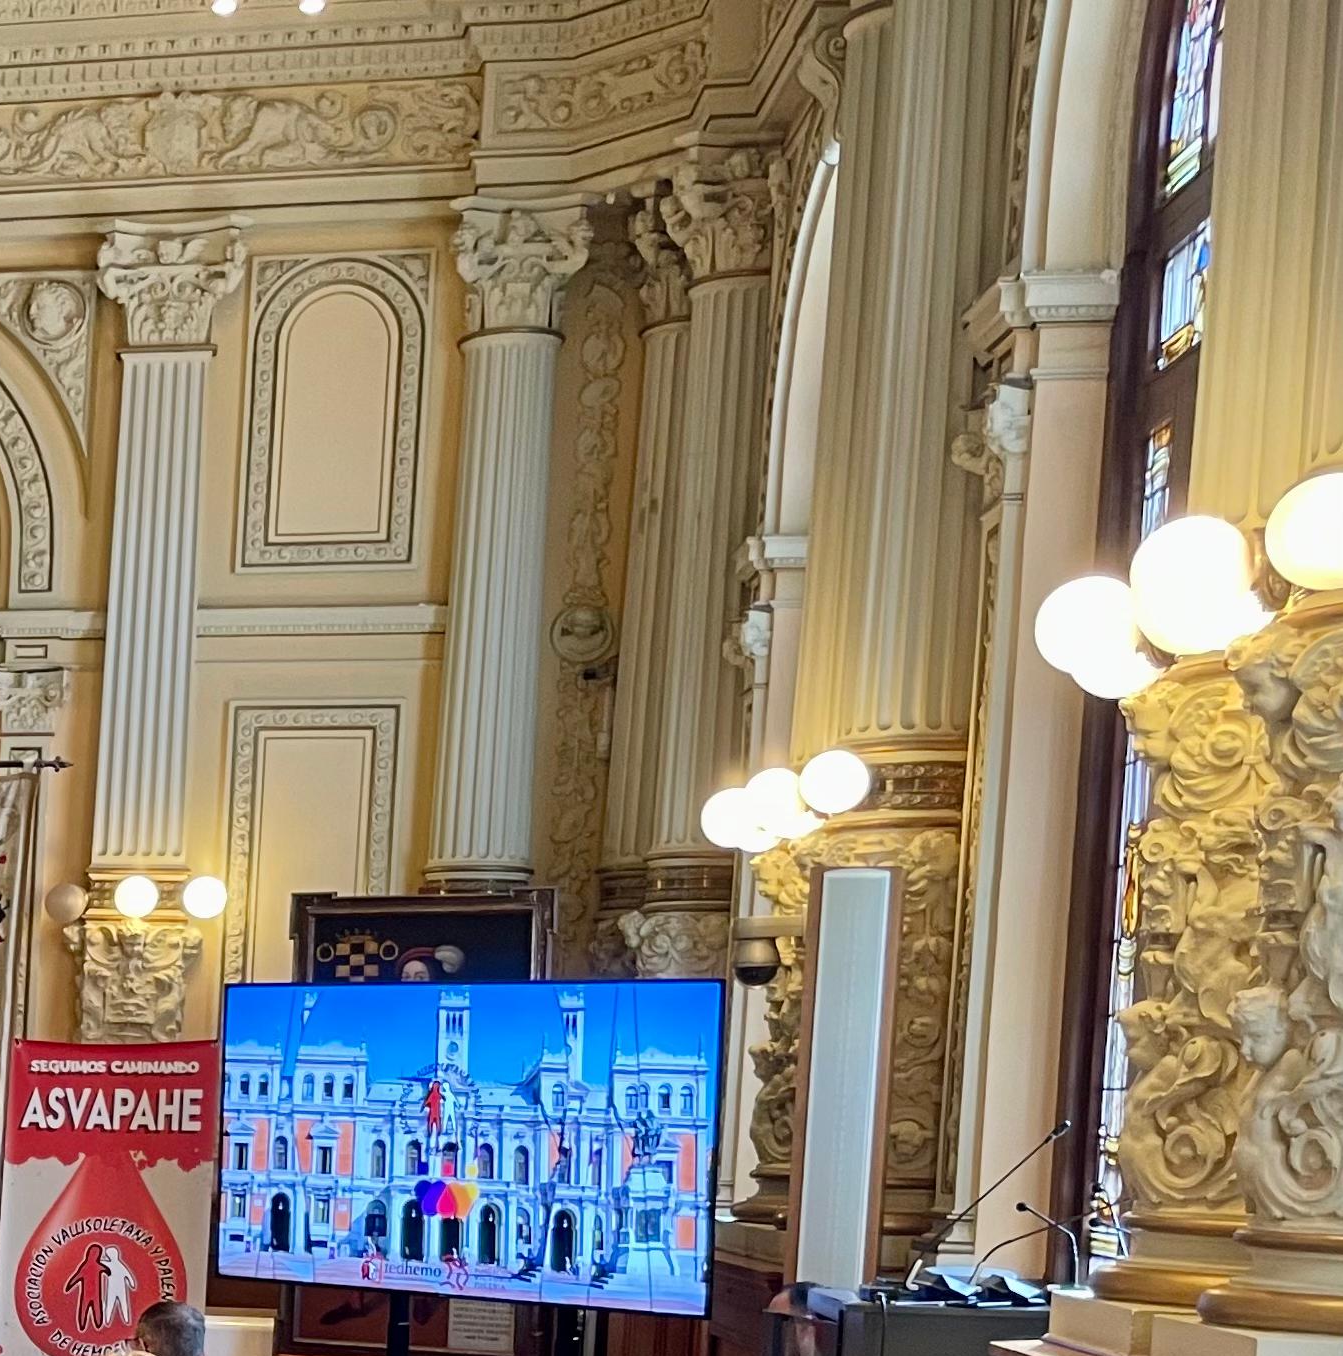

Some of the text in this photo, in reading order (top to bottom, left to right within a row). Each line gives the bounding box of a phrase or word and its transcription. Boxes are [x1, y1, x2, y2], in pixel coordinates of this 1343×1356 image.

[30, 1059, 200, 1074] SEGUIMOS CAMINANDO
[20, 1086, 205, 1132] ASVAPAHE
[51, 1218, 154, 1248] VALLISOLETANA
[149, 1245, 164, 1255] Y
[154, 1257, 177, 1303] PALEN
[50, 1329, 72, 1349] DE
